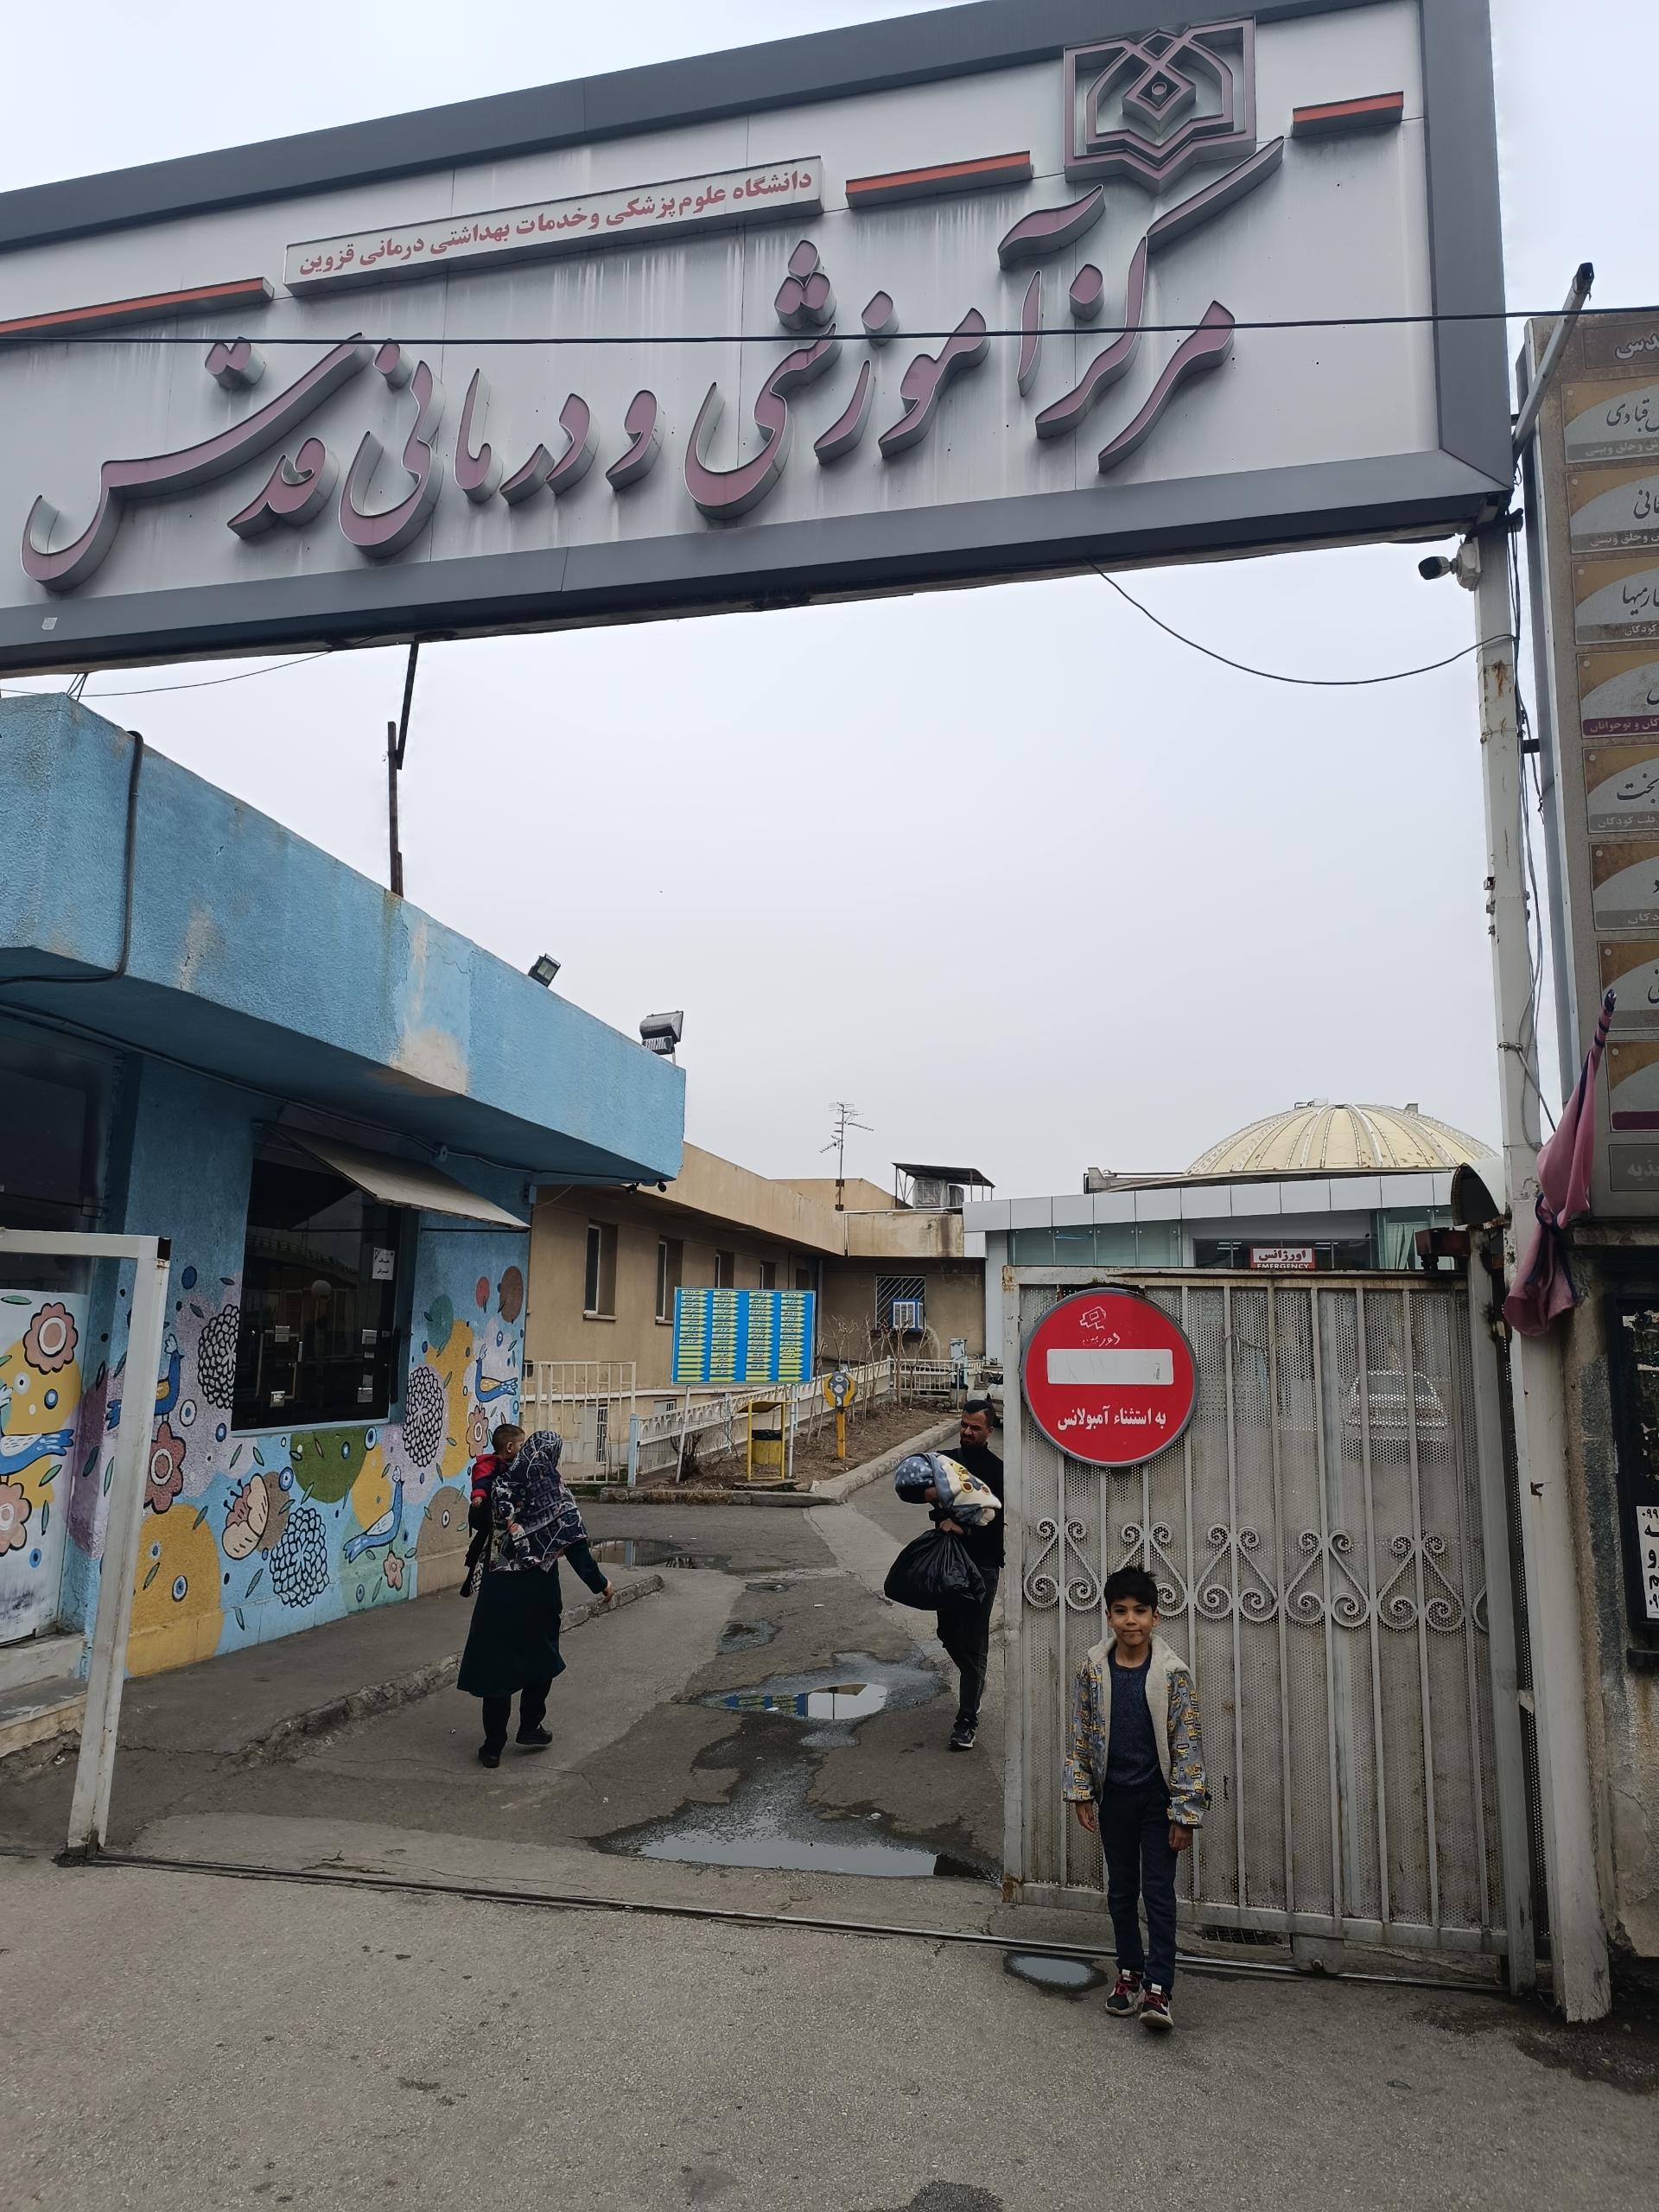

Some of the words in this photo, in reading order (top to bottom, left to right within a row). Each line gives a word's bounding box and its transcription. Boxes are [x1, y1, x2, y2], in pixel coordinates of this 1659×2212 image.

[678, 185, 726, 214] علوم
[732, 171, 811, 200] دانشگاه
[606, 195, 676, 226] پزشکی
[359, 238, 424, 267] درمانی
[429, 221, 511, 255] بهداشتی
[299, 245, 354, 276] قزوین
[1035, 135, 1285, 472] مرکز
[684, 184, 1106, 514] آموزشی
[1615, 333, 1659, 360] دس
[20, 332, 373, 590] قدس
[339, 338, 598, 555] درمانی
[1258, 1249, 1306, 1262] اورژانس
[1058, 1405, 1110, 1431] آمبولانس
[1113, 1408, 1152, 1426] استثناء
[1154, 1410, 1166, 1430] به
